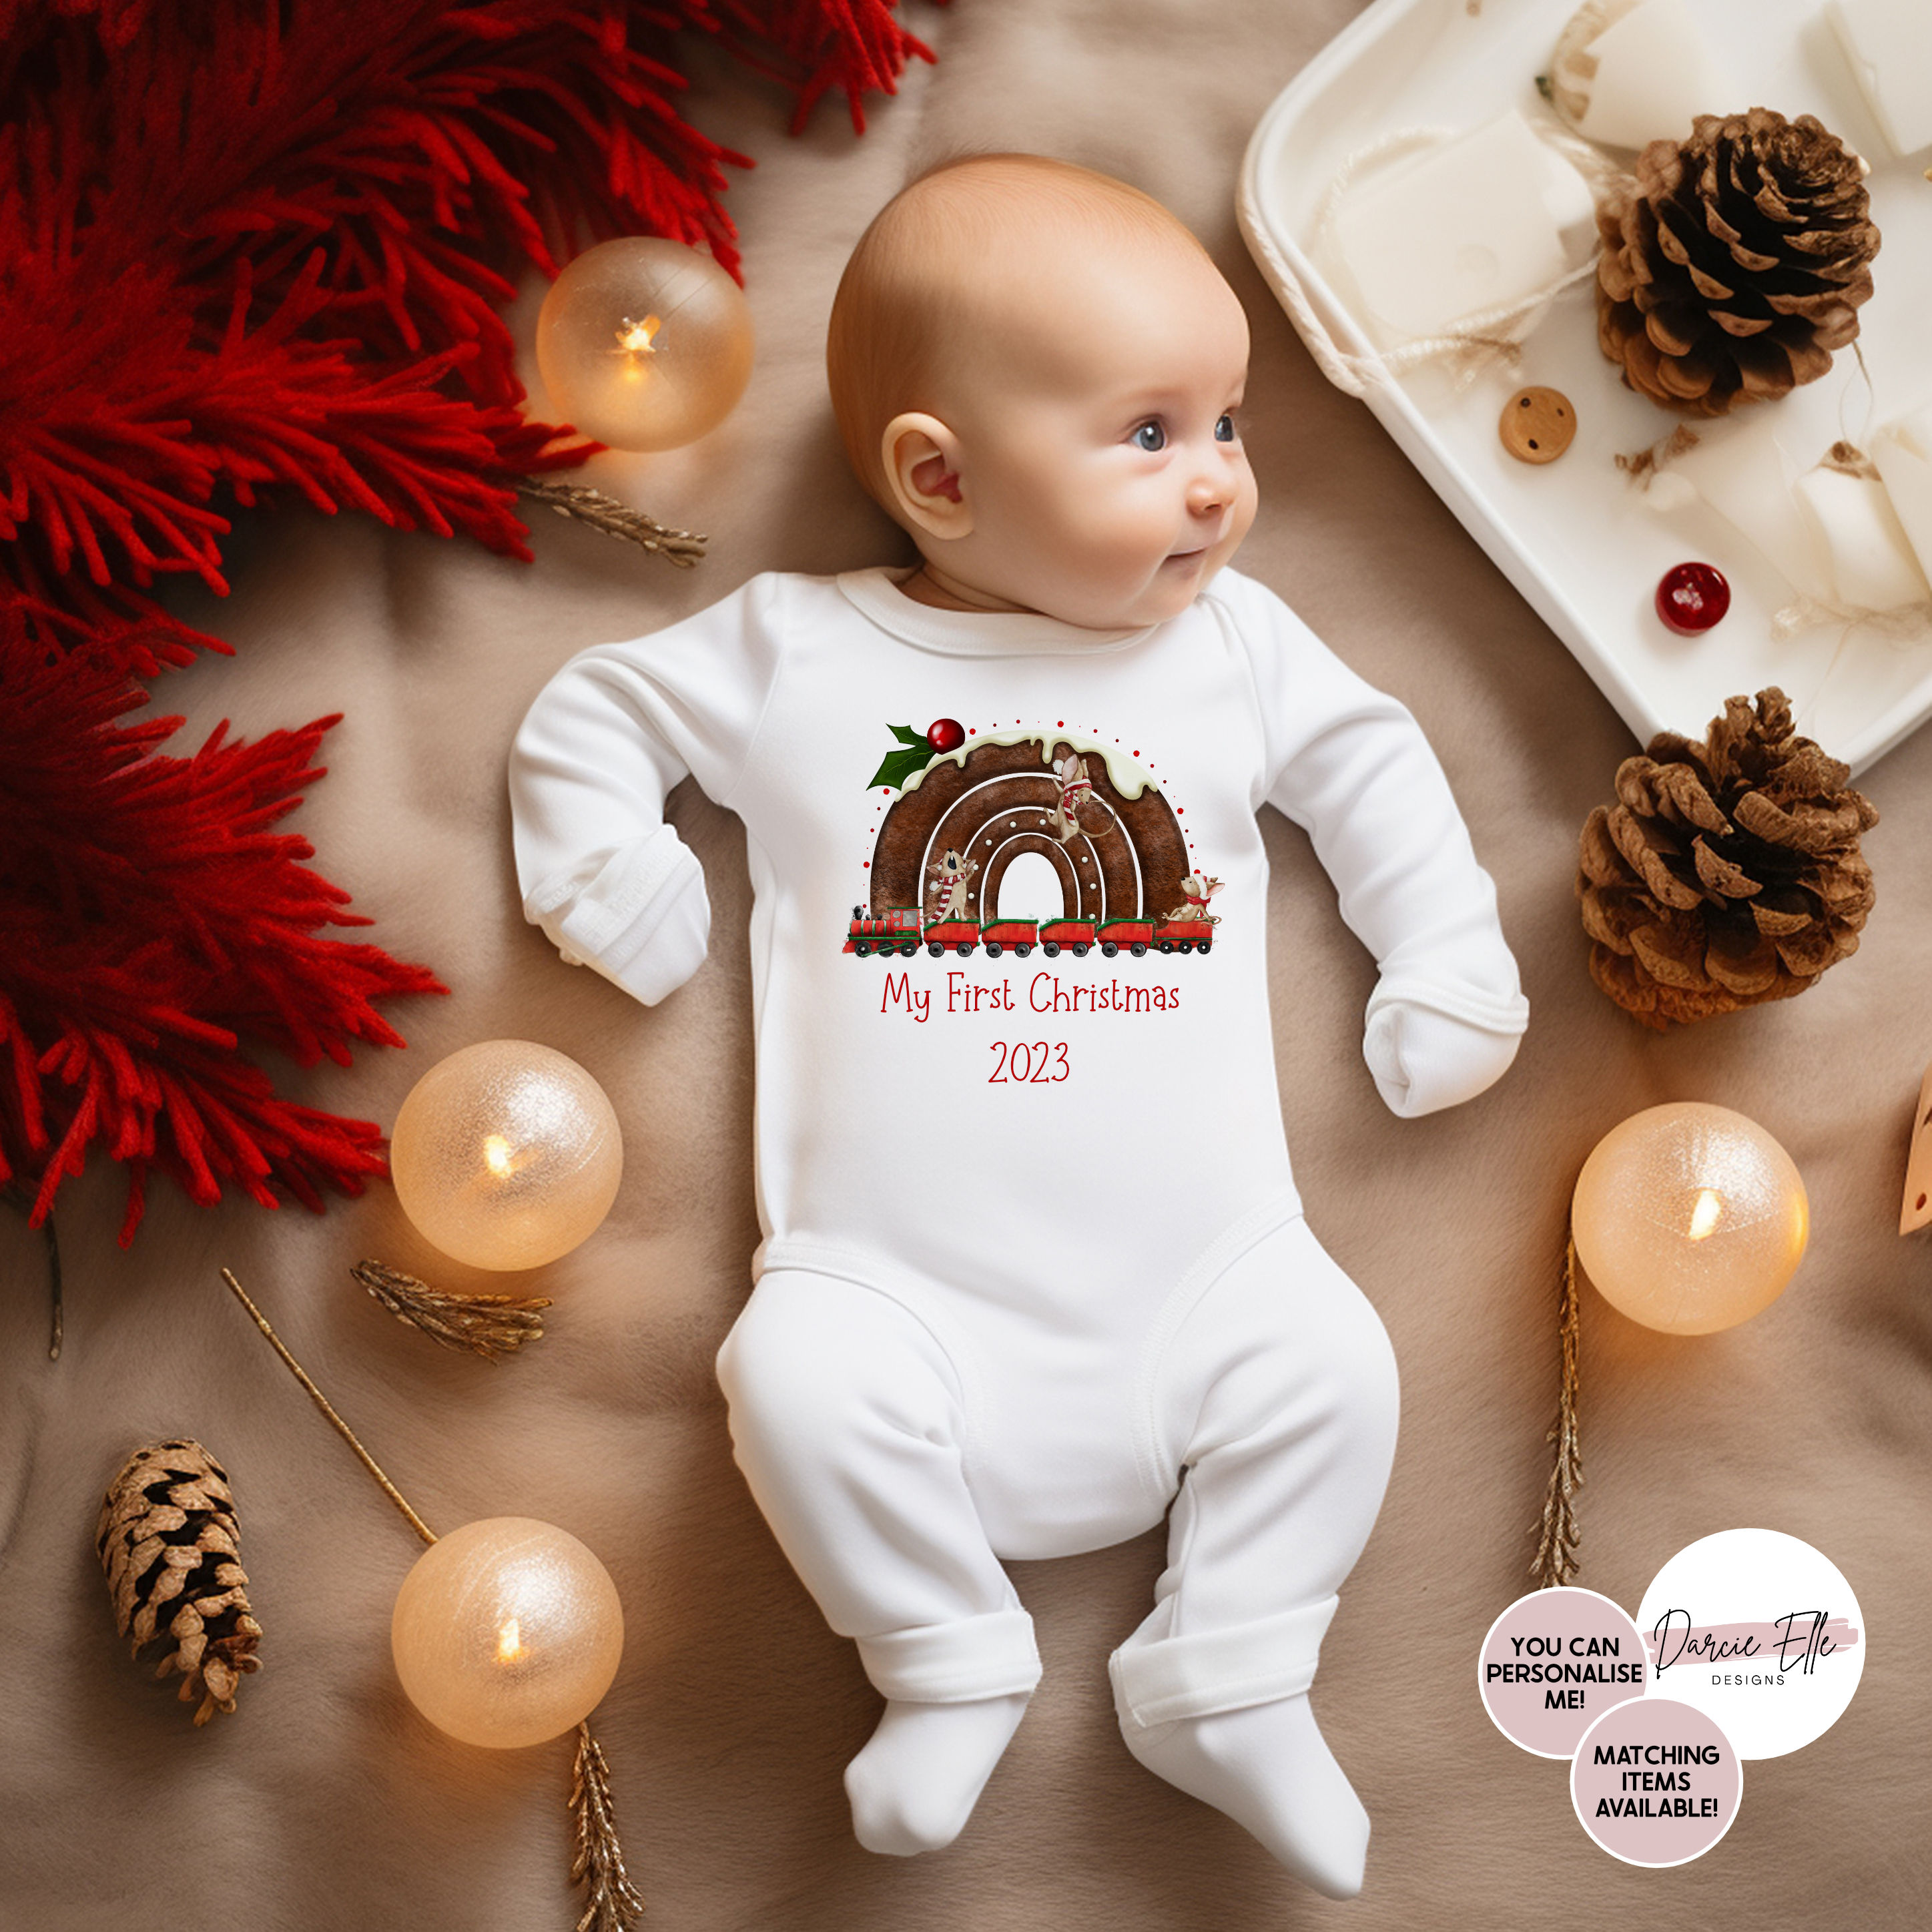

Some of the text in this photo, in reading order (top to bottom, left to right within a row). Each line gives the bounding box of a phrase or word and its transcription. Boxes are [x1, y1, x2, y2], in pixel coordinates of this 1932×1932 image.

[880, 972, 1179, 1023] My First Christmas
[988, 1041, 1070, 1083] 2023
